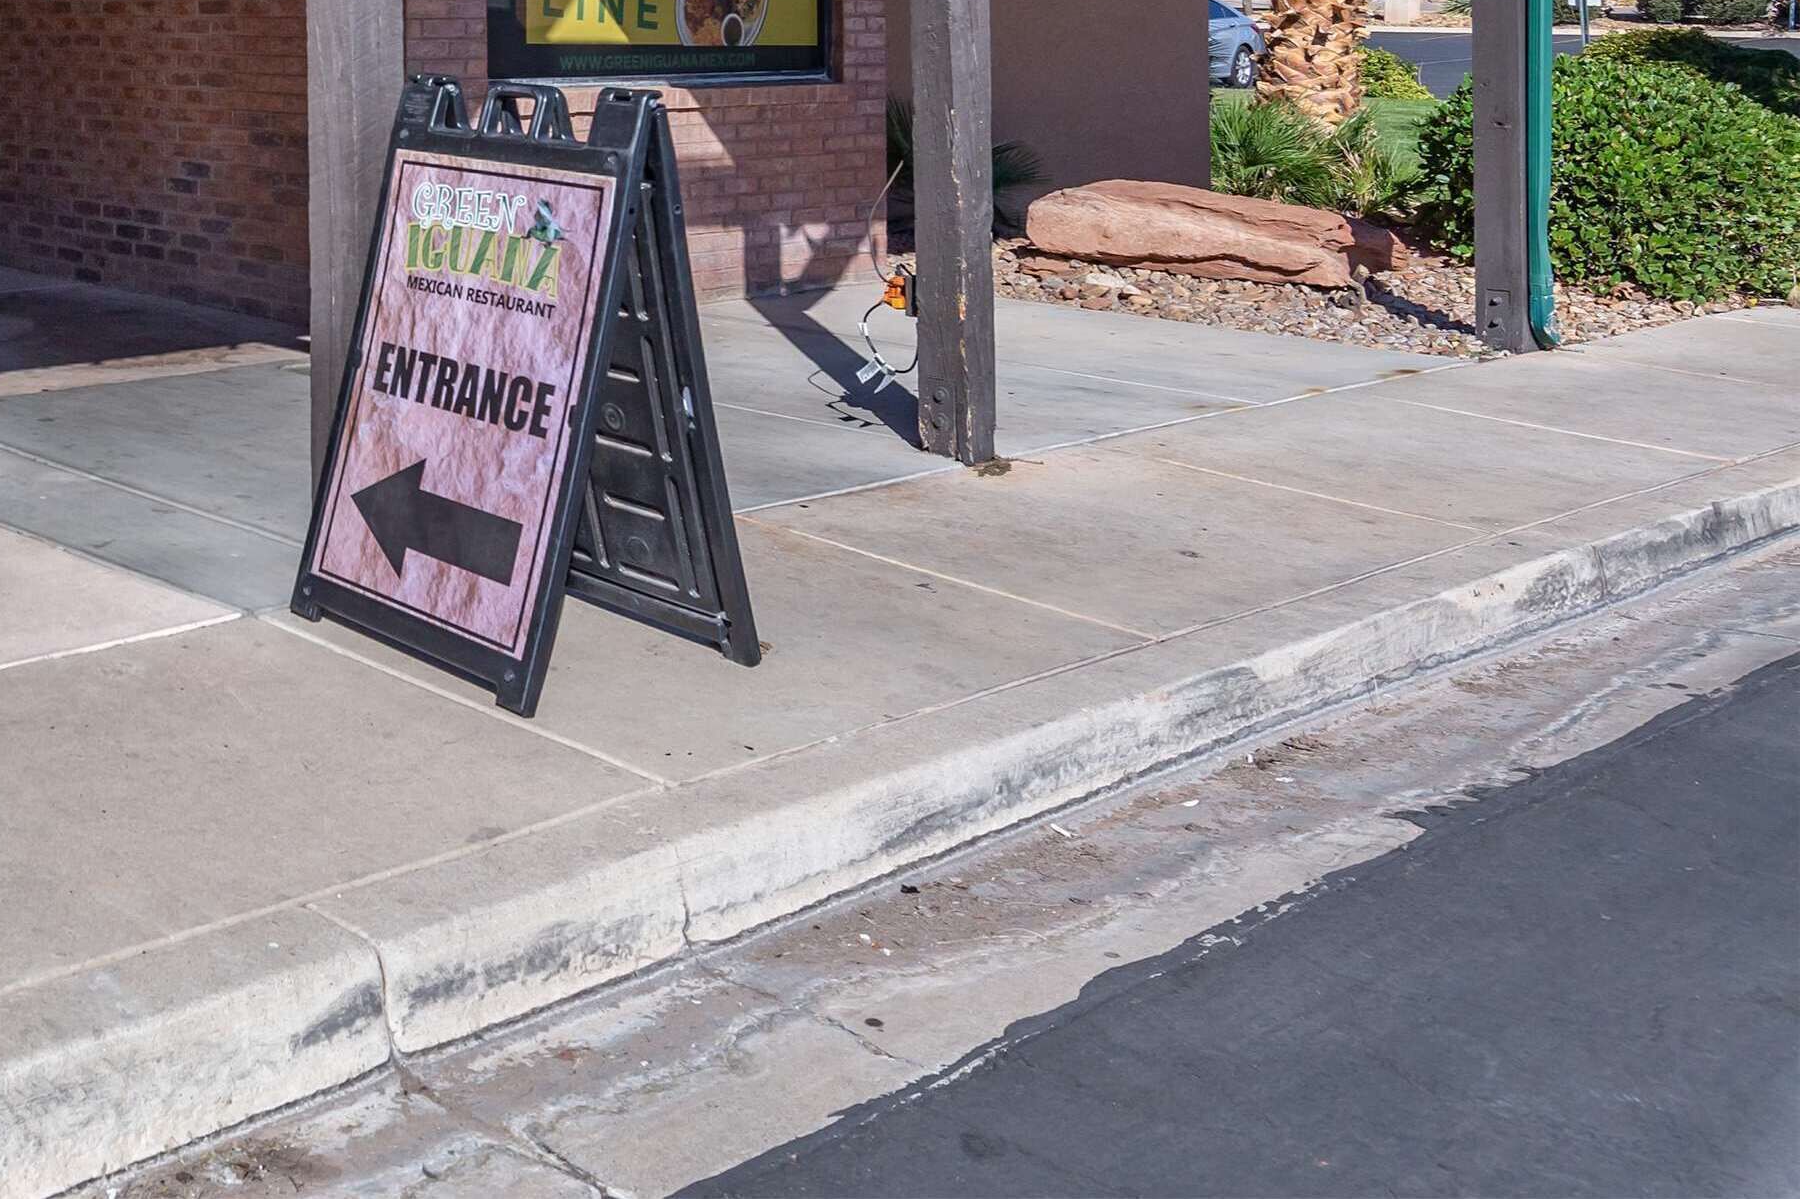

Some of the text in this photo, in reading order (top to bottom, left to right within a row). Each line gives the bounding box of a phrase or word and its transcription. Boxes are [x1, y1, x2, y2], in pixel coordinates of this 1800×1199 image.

[412, 180, 527, 233] GREEN
[404, 221, 562, 299] IGUANA
[406, 275, 556, 319] MEXICAN RESTAURANT
[373, 342, 556, 439] ENTRANCE
